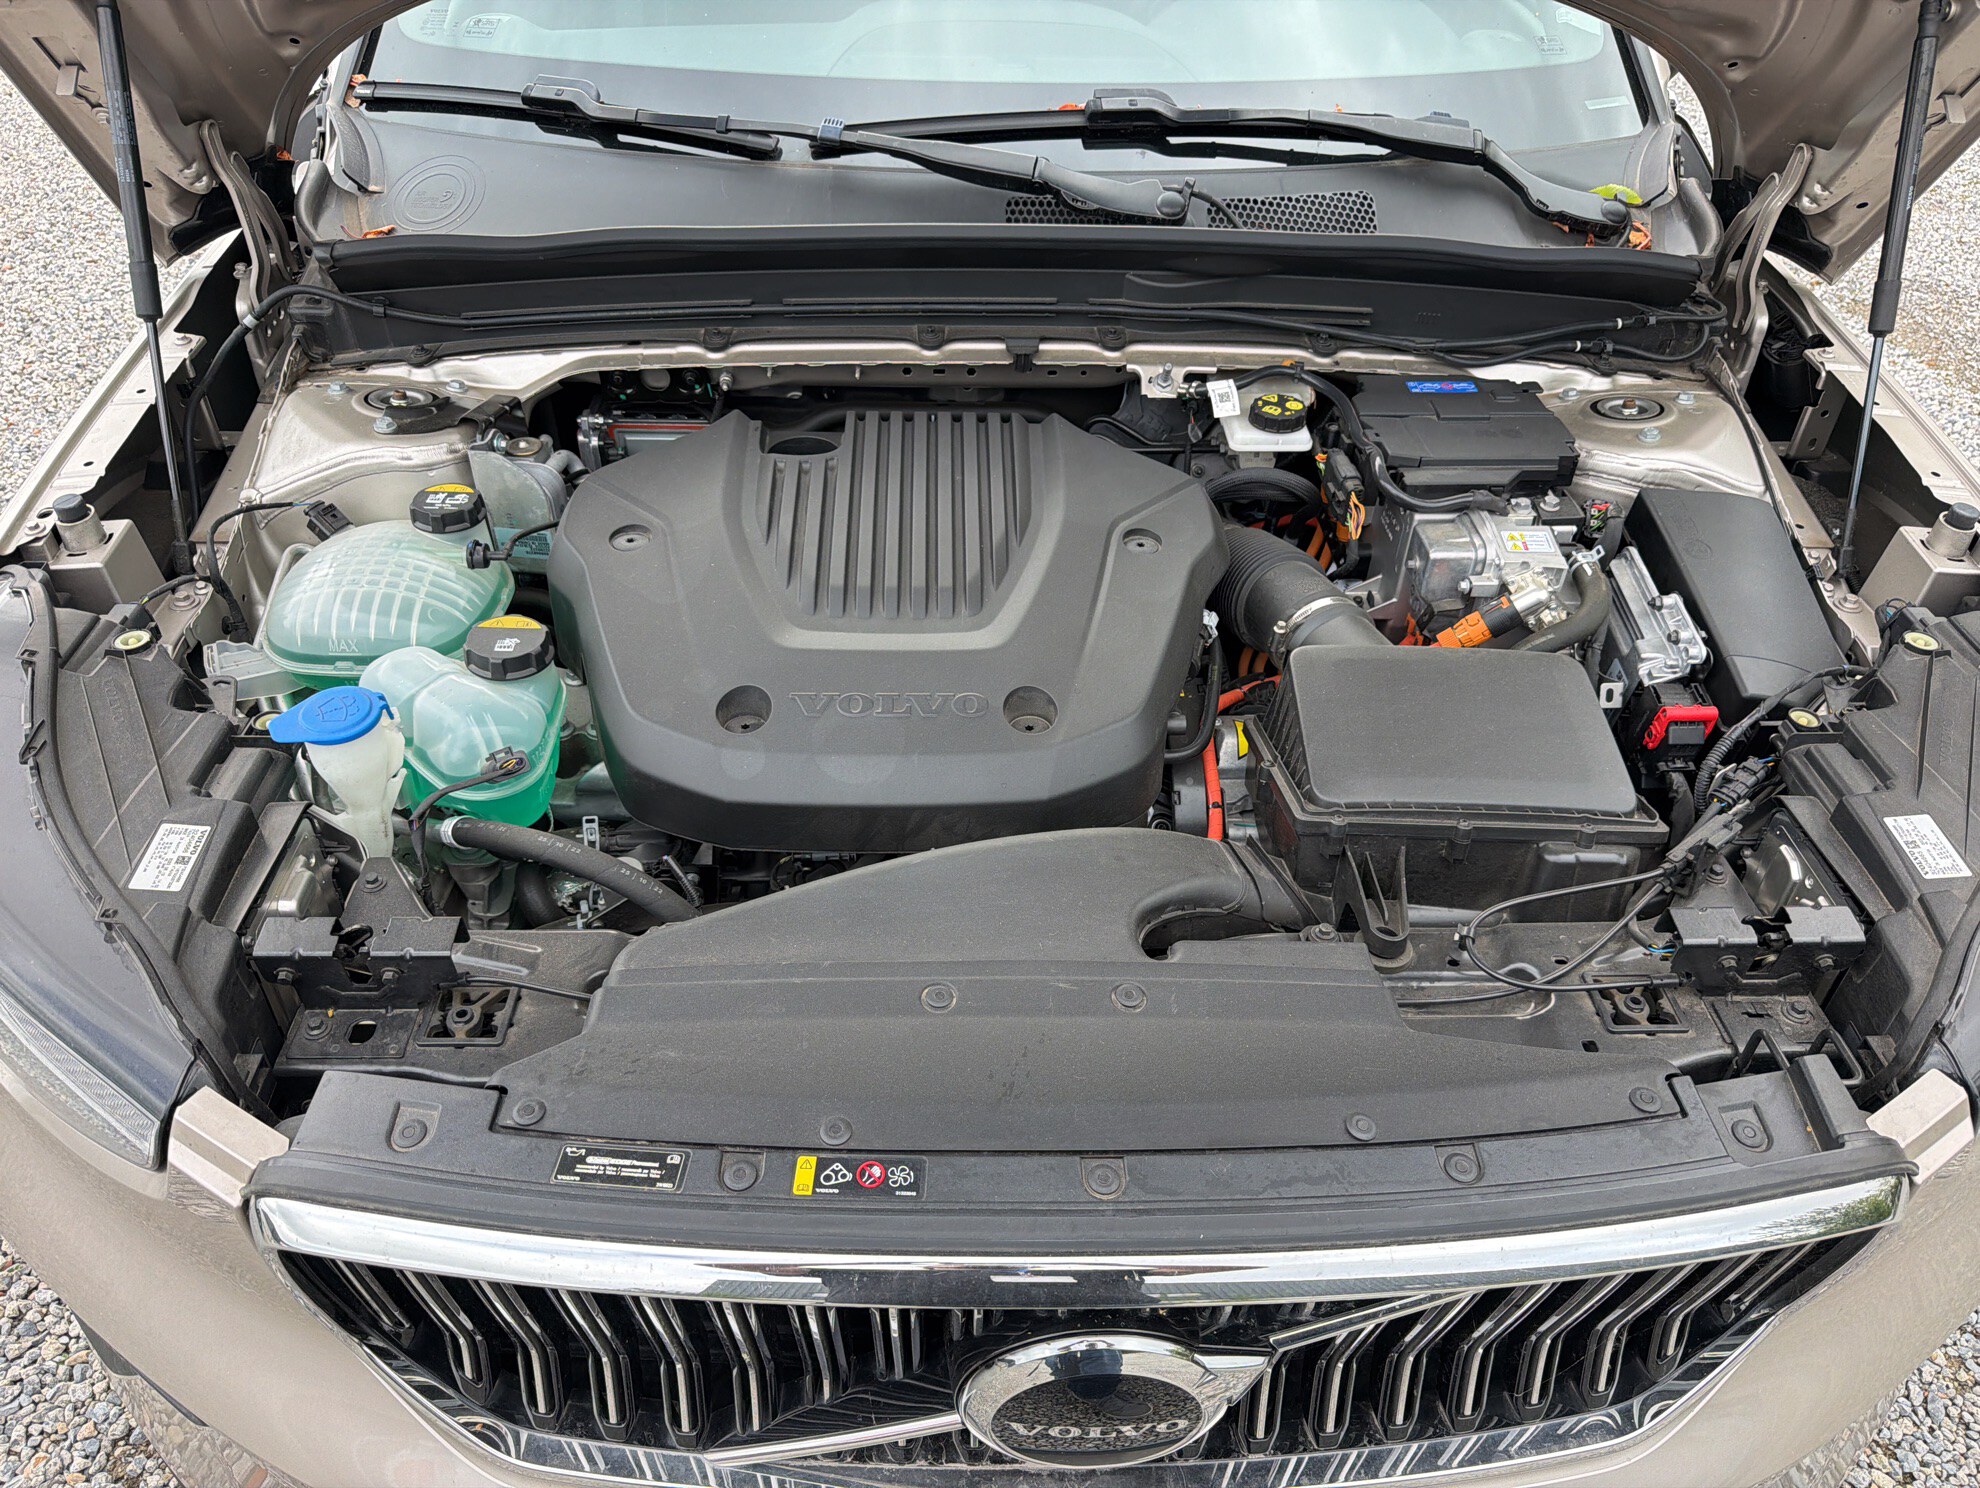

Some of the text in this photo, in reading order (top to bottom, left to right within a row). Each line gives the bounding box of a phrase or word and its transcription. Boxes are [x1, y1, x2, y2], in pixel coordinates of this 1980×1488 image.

[328, 638, 359, 652] MAX
[788, 692, 990, 718] VOLVO
[189, 829, 208, 855] VOLVO
[1908, 850, 1929, 876] VOLVO
[1004, 1419, 1190, 1438] VOLVO
